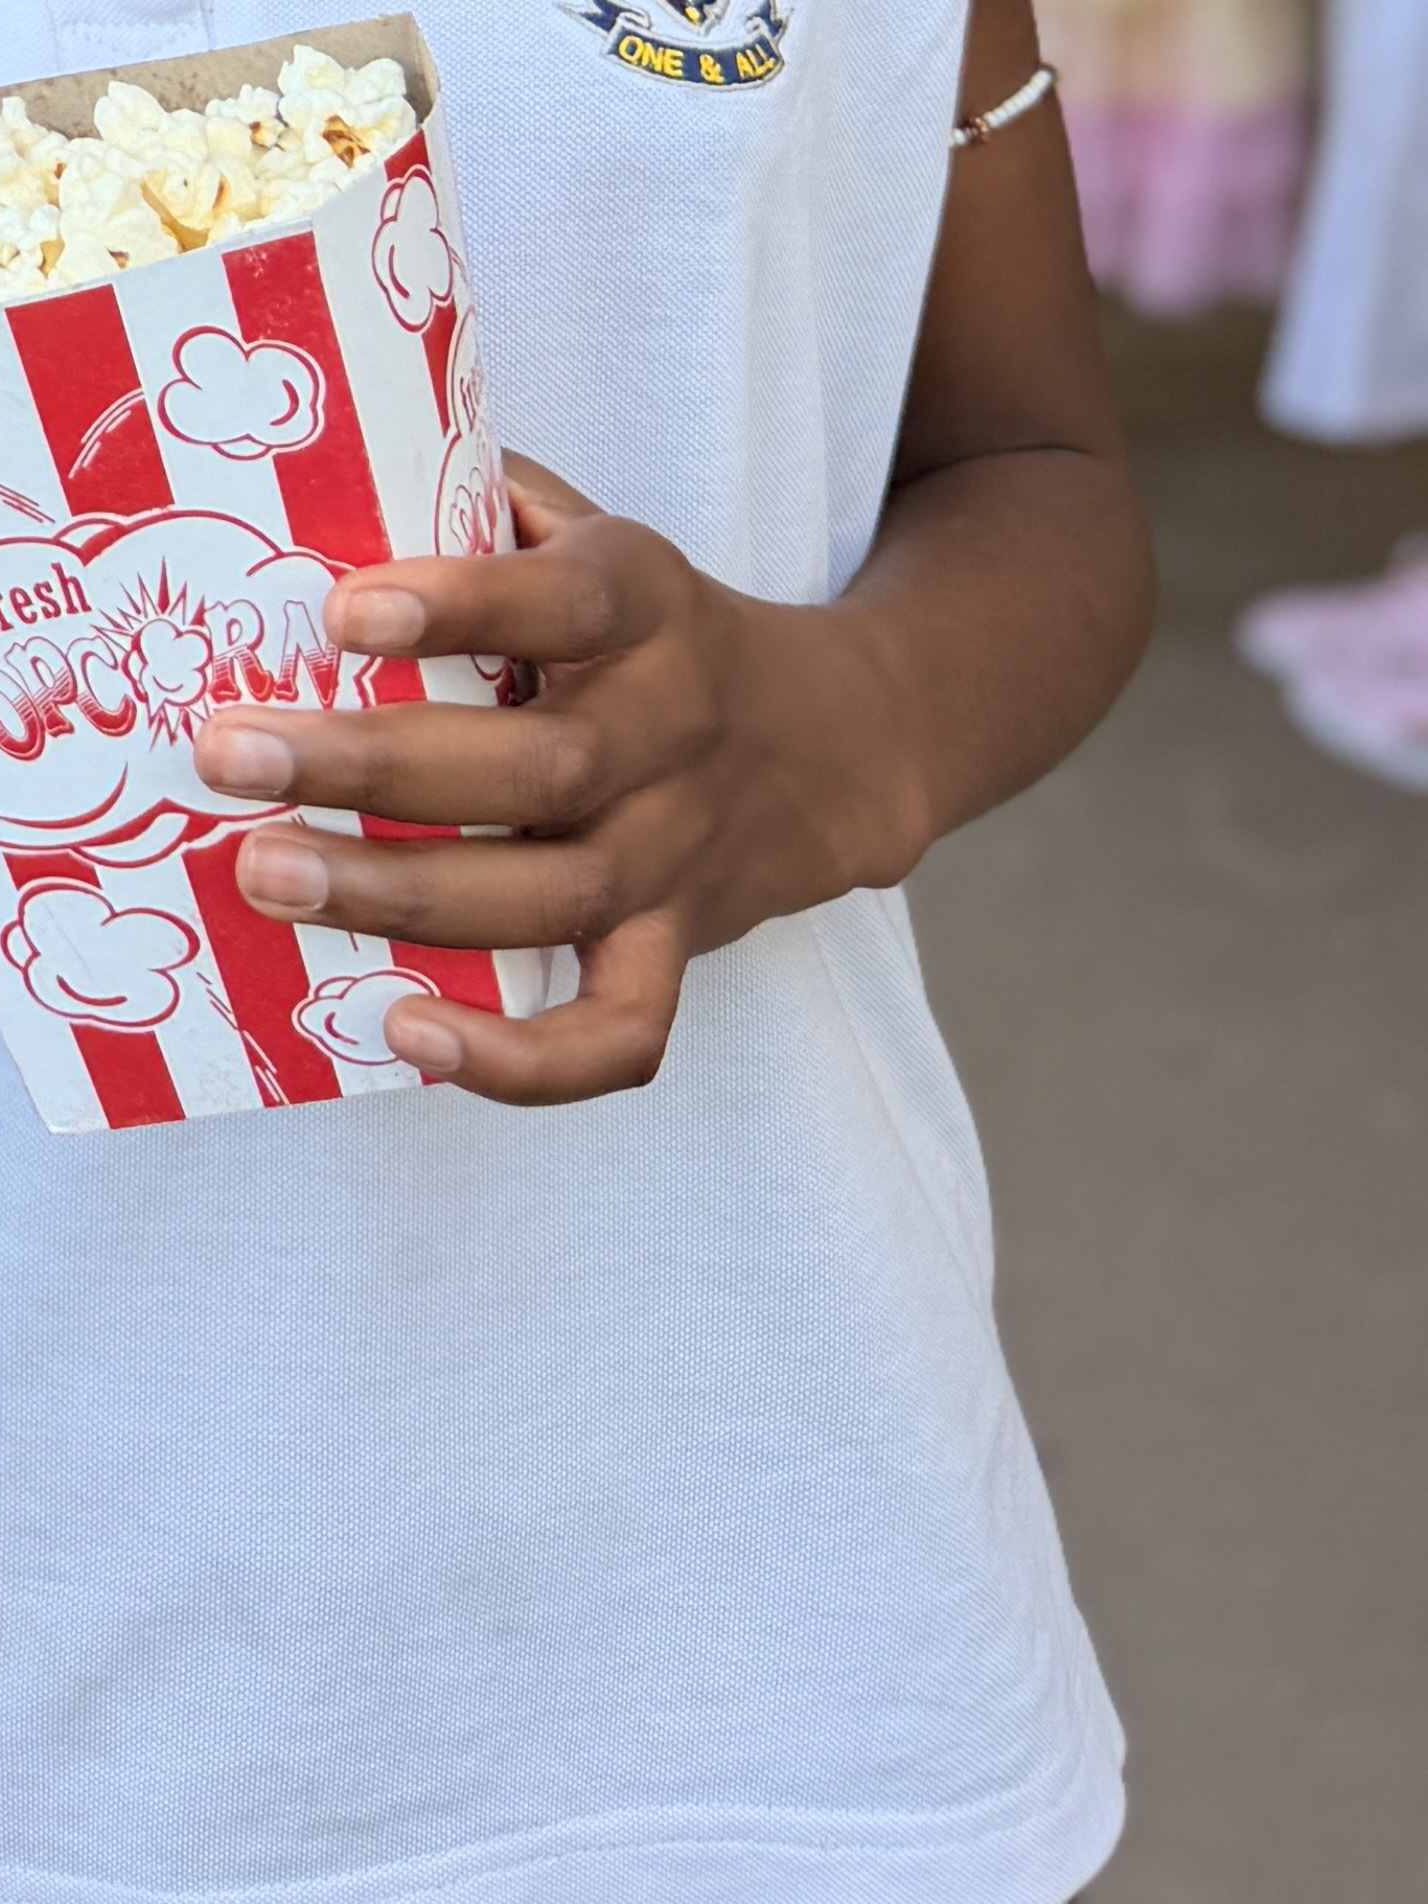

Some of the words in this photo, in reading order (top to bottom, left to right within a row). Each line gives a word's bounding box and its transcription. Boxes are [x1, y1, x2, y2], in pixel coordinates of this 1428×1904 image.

[618, 35, 684, 78] ONE
[699, 53, 725, 84] &
[735, 43, 776, 80] ALL
